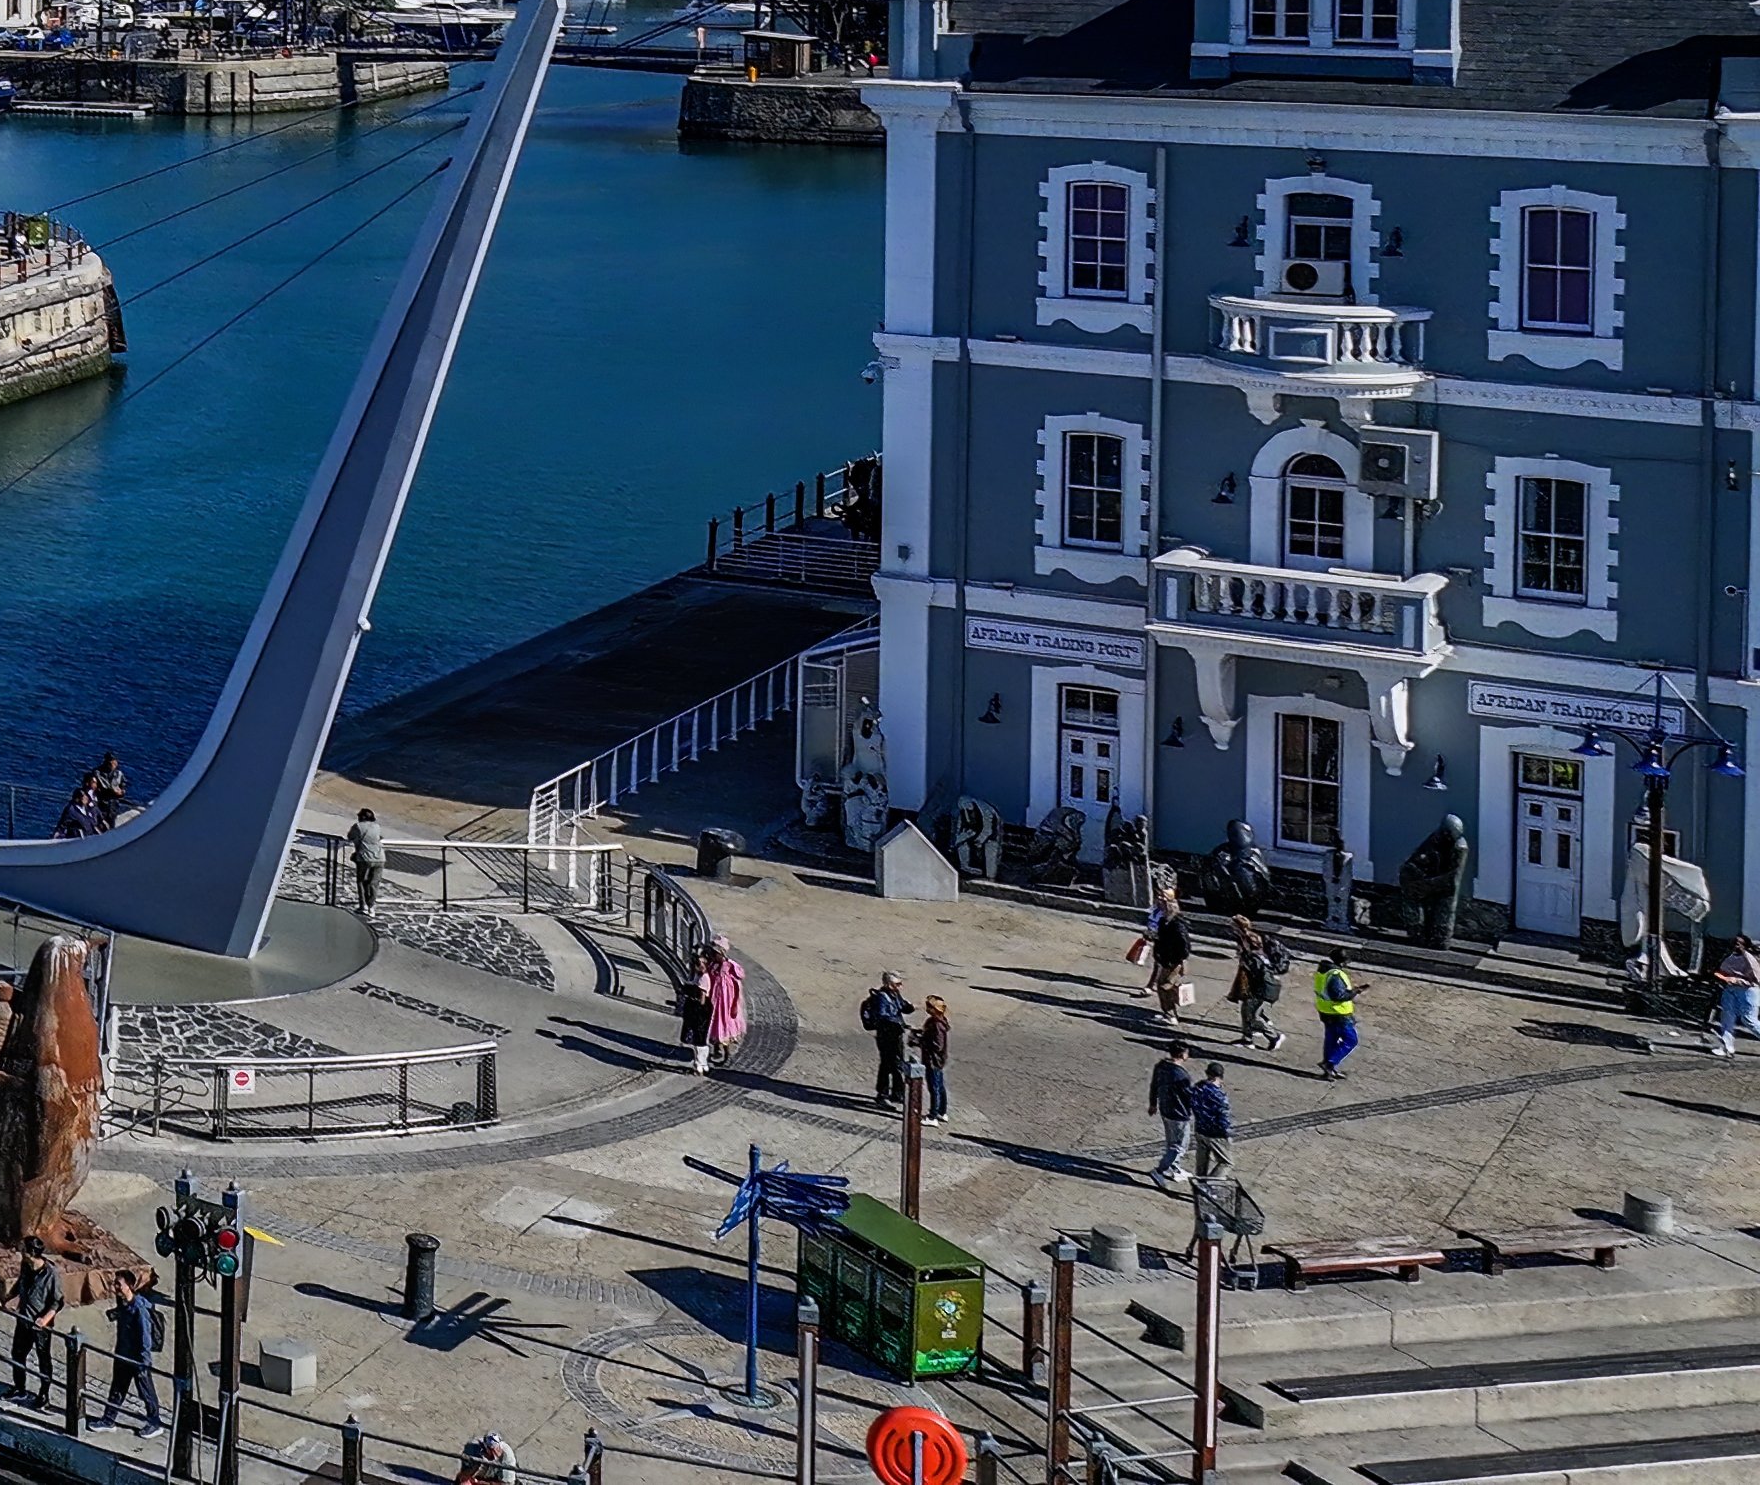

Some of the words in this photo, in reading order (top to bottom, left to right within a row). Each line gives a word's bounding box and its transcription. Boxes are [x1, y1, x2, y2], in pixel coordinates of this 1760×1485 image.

[971, 626, 1031, 645] AFRICAN
[1033, 634, 1095, 653] TRADING
[1476, 693, 1547, 713] AFRICAN
[1550, 702, 1623, 723] TRADING
